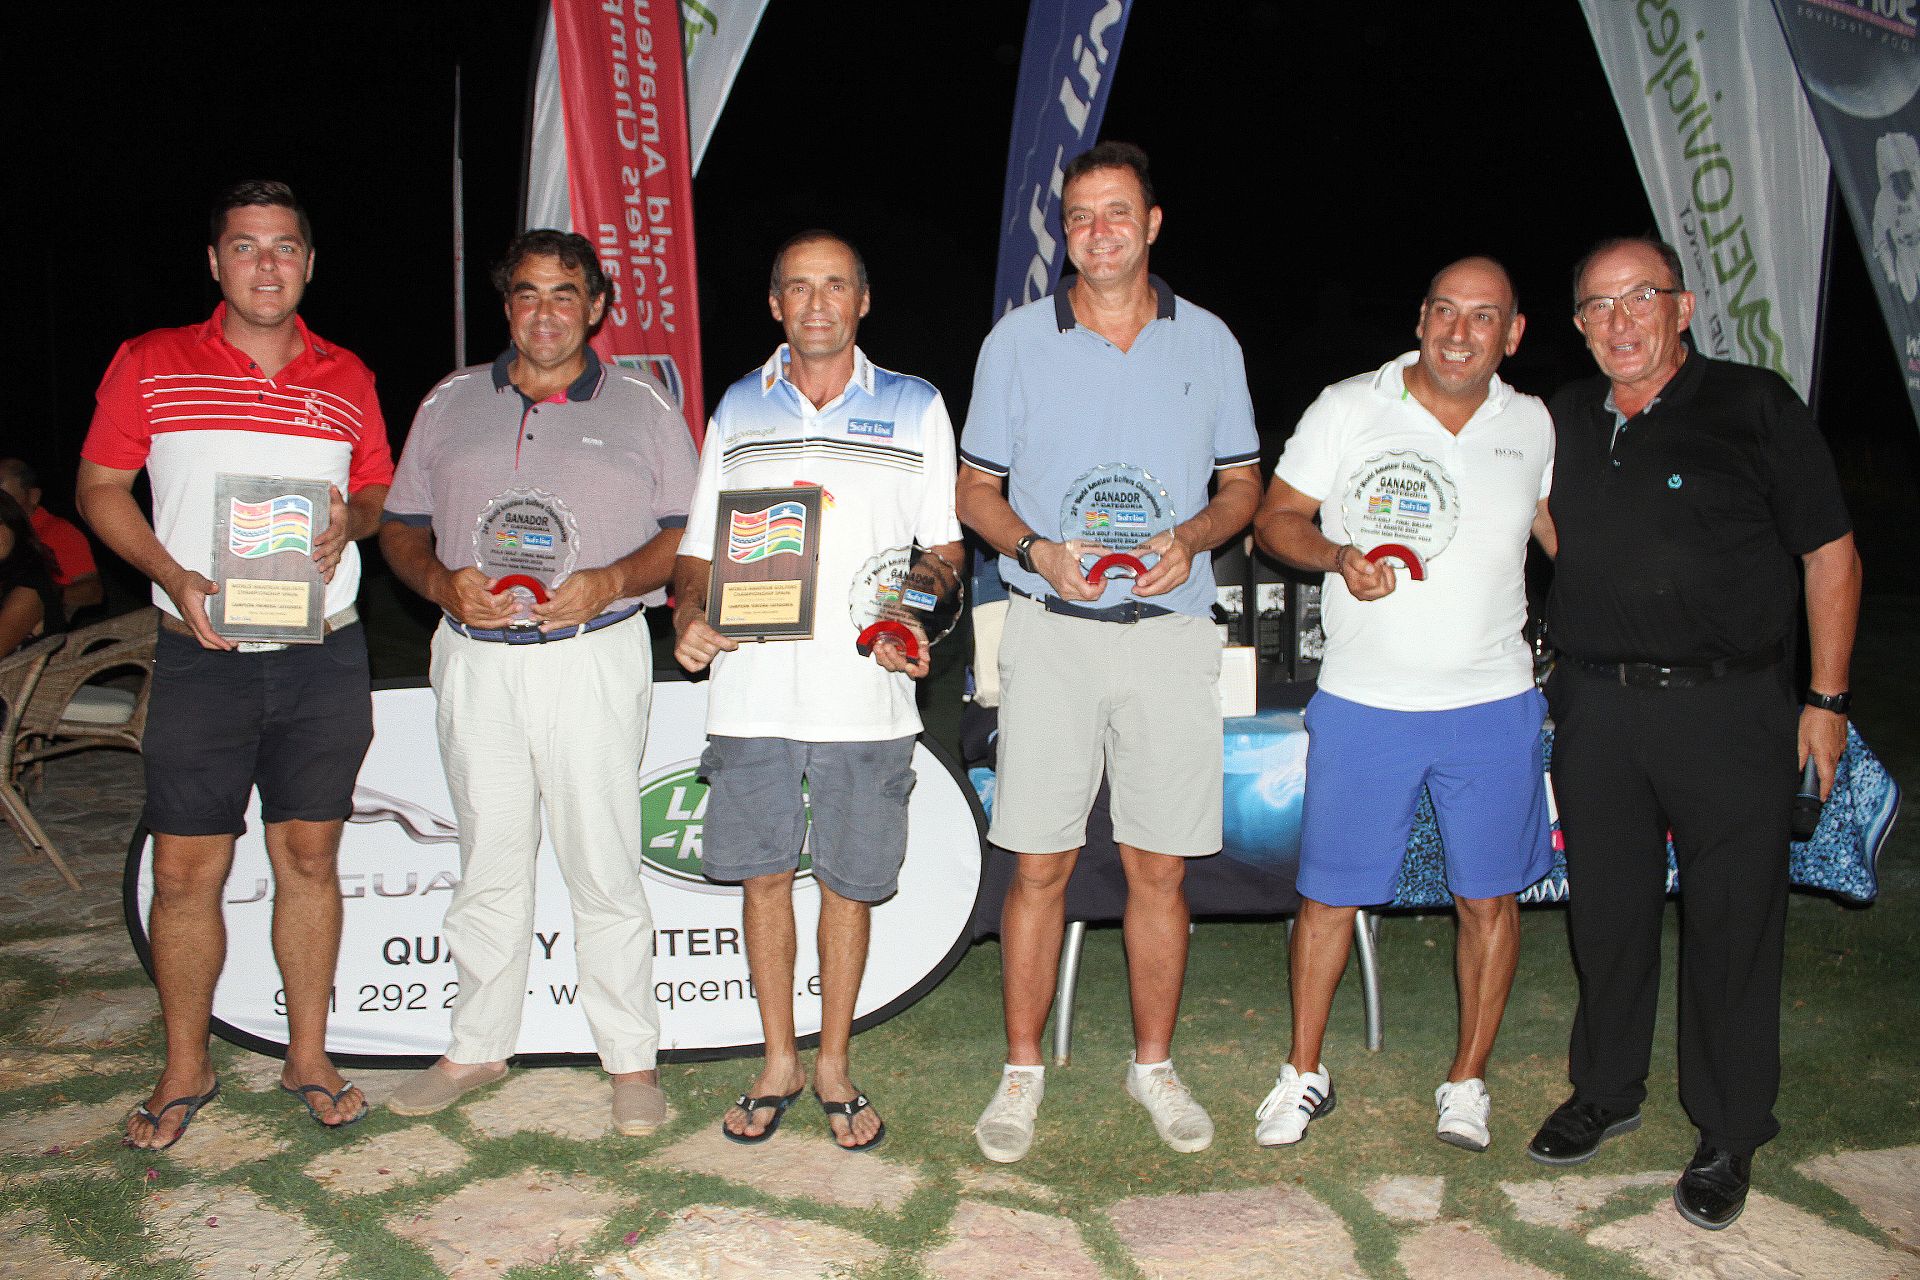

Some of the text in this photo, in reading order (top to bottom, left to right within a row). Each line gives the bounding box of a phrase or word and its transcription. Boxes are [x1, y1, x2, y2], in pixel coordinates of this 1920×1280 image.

[1495, 448, 1523, 460] BOSS
[1380, 477, 1426, 492] GANADOR
[1095, 491, 1140, 503] GANADOR
[505, 513, 549, 526] GANADOR
[891, 568, 935, 585] GANADOR
[273, 985, 337, 1016] 91
[358, 983, 427, 1012] 292
